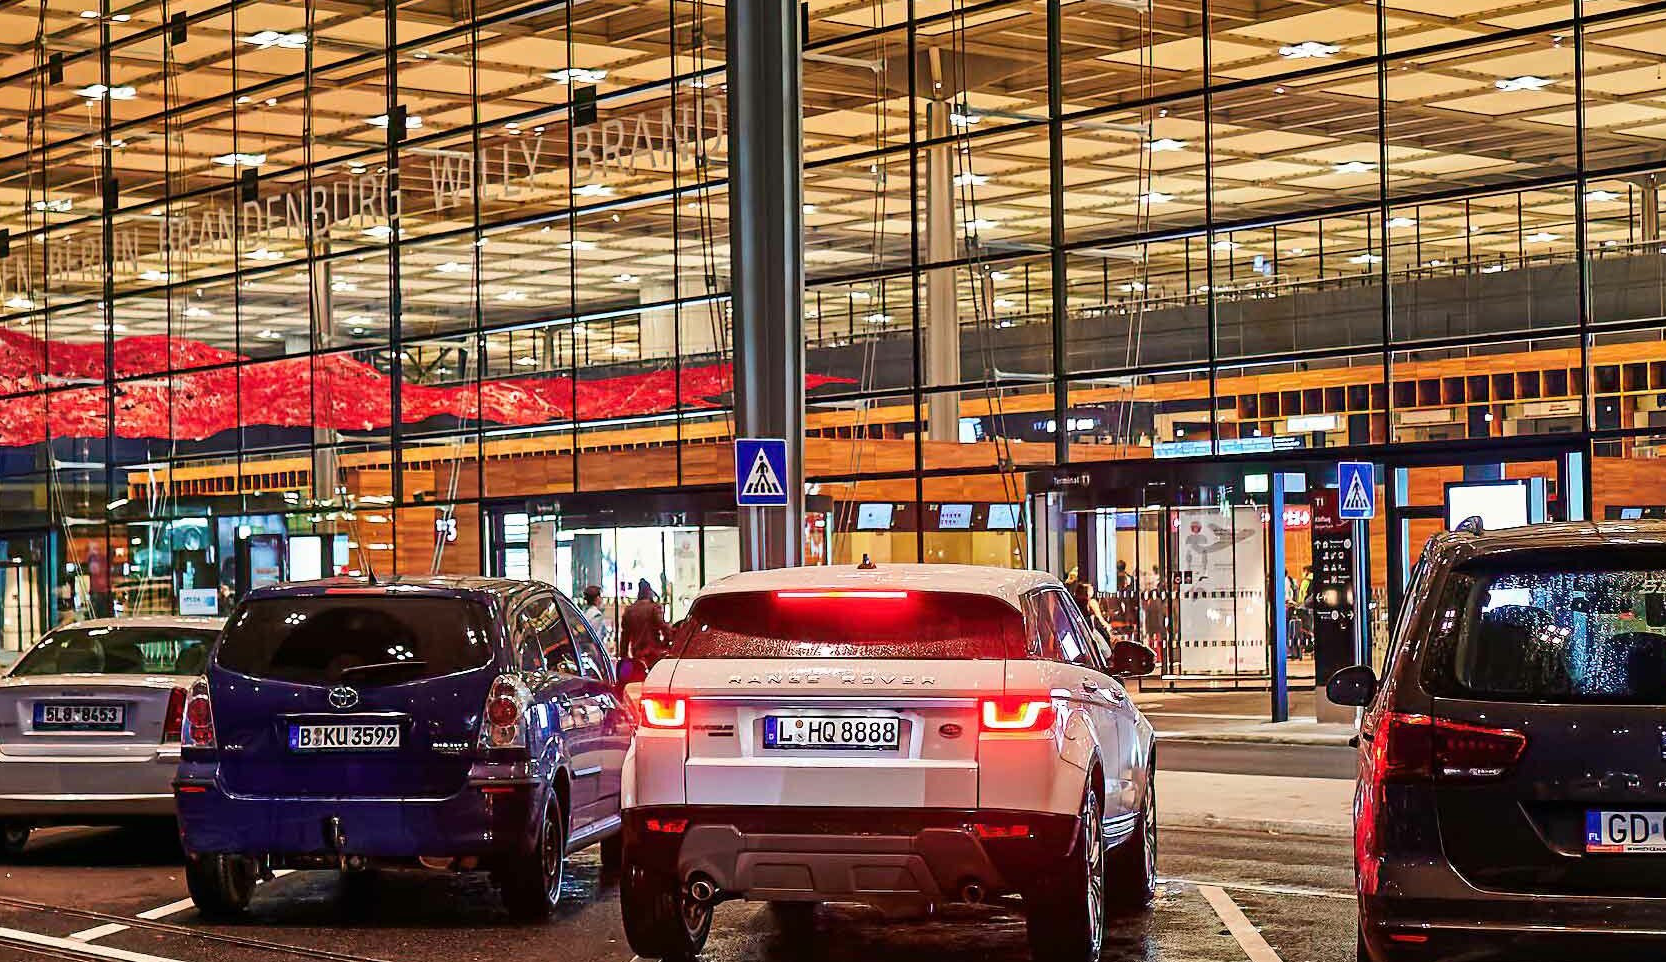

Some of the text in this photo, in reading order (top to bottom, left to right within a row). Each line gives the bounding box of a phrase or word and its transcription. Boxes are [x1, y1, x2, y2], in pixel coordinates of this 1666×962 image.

[158, 168, 401, 262] BRANDENBURG
[429, 136, 542, 211] WILLY
[573, 97, 724, 181] BRAND
[728, 673, 936, 685] RANGE ROVER
[351, 726, 398, 746] 3599
[841, 721, 896, 743] 8888
